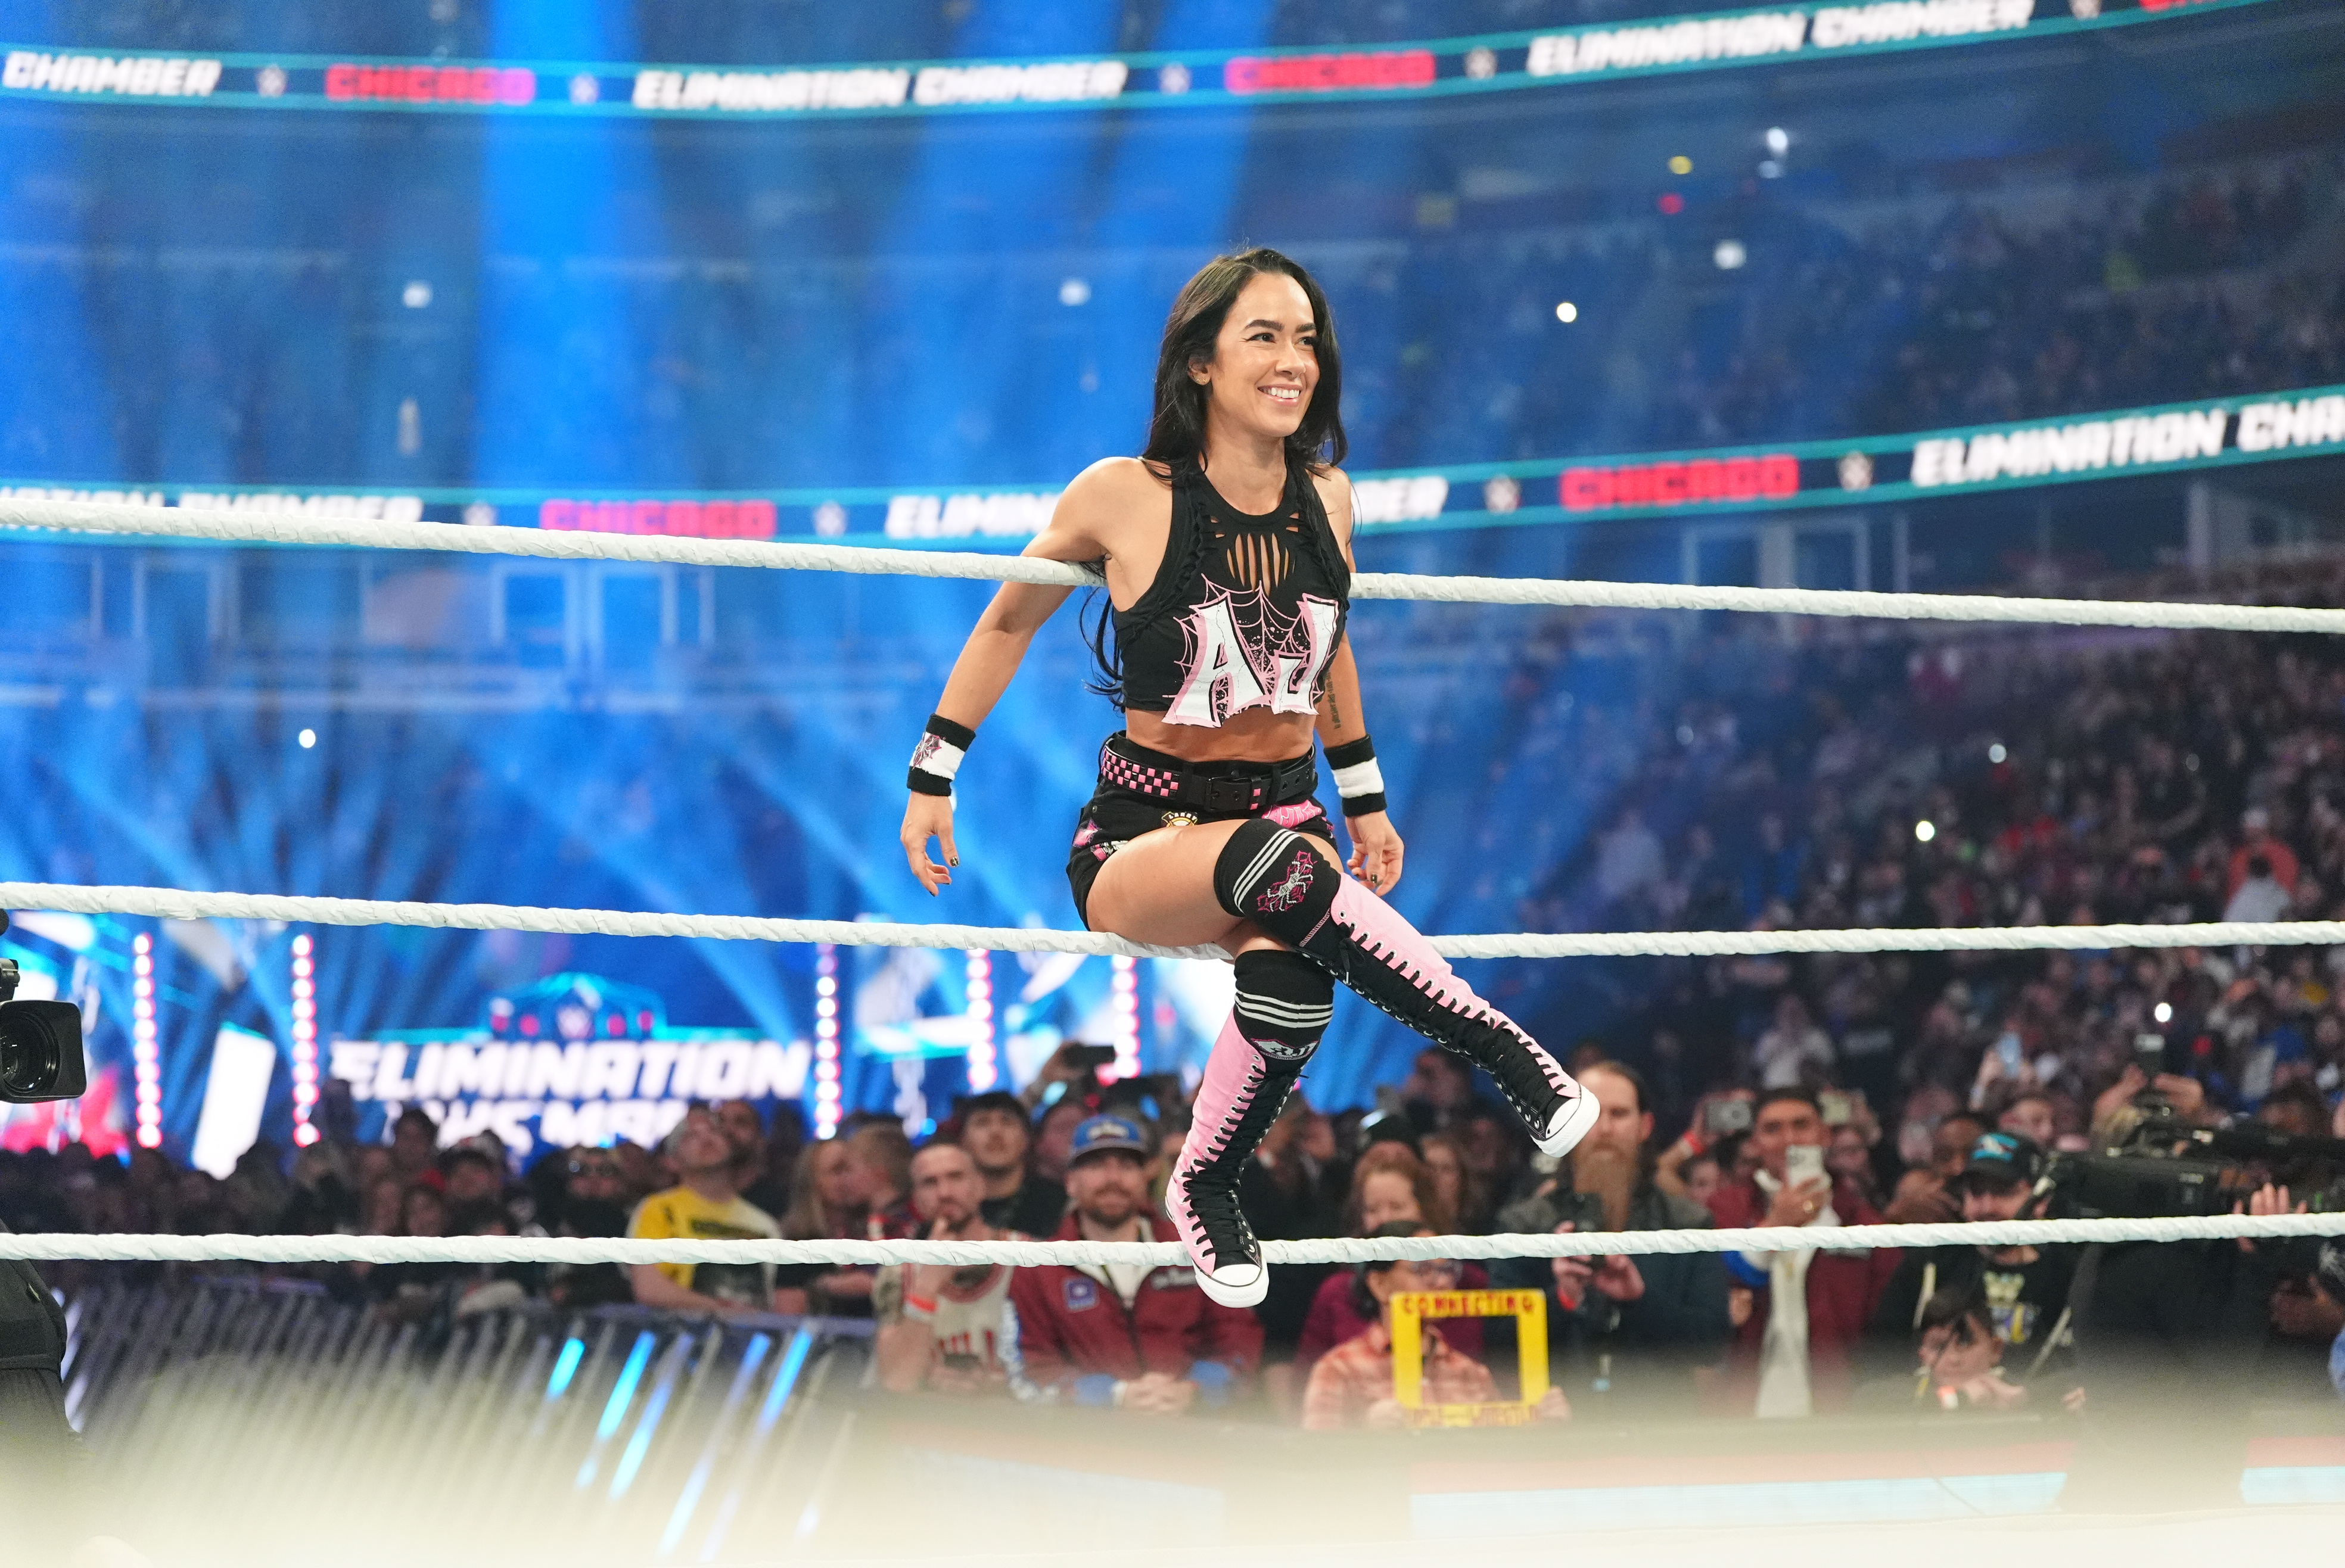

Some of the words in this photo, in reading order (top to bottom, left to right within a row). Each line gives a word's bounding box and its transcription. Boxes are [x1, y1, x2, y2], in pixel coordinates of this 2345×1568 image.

[1527, 12, 1806, 77] ELIMINATION
[1811, 0, 2034, 47] CHAMBER
[3, 51, 221, 96] CHAMBER
[325, 63, 536, 105] CHICAGO
[632, 70, 910, 110] ELIMINATION
[913, 61, 1128, 105] CHAMBER
[1911, 409, 2227, 487] ELIMINATION
[1560, 454, 1799, 511] CHICAGO
[1161, 592, 1339, 728] AJ
[331, 1040, 813, 1100] ELIMINATION
